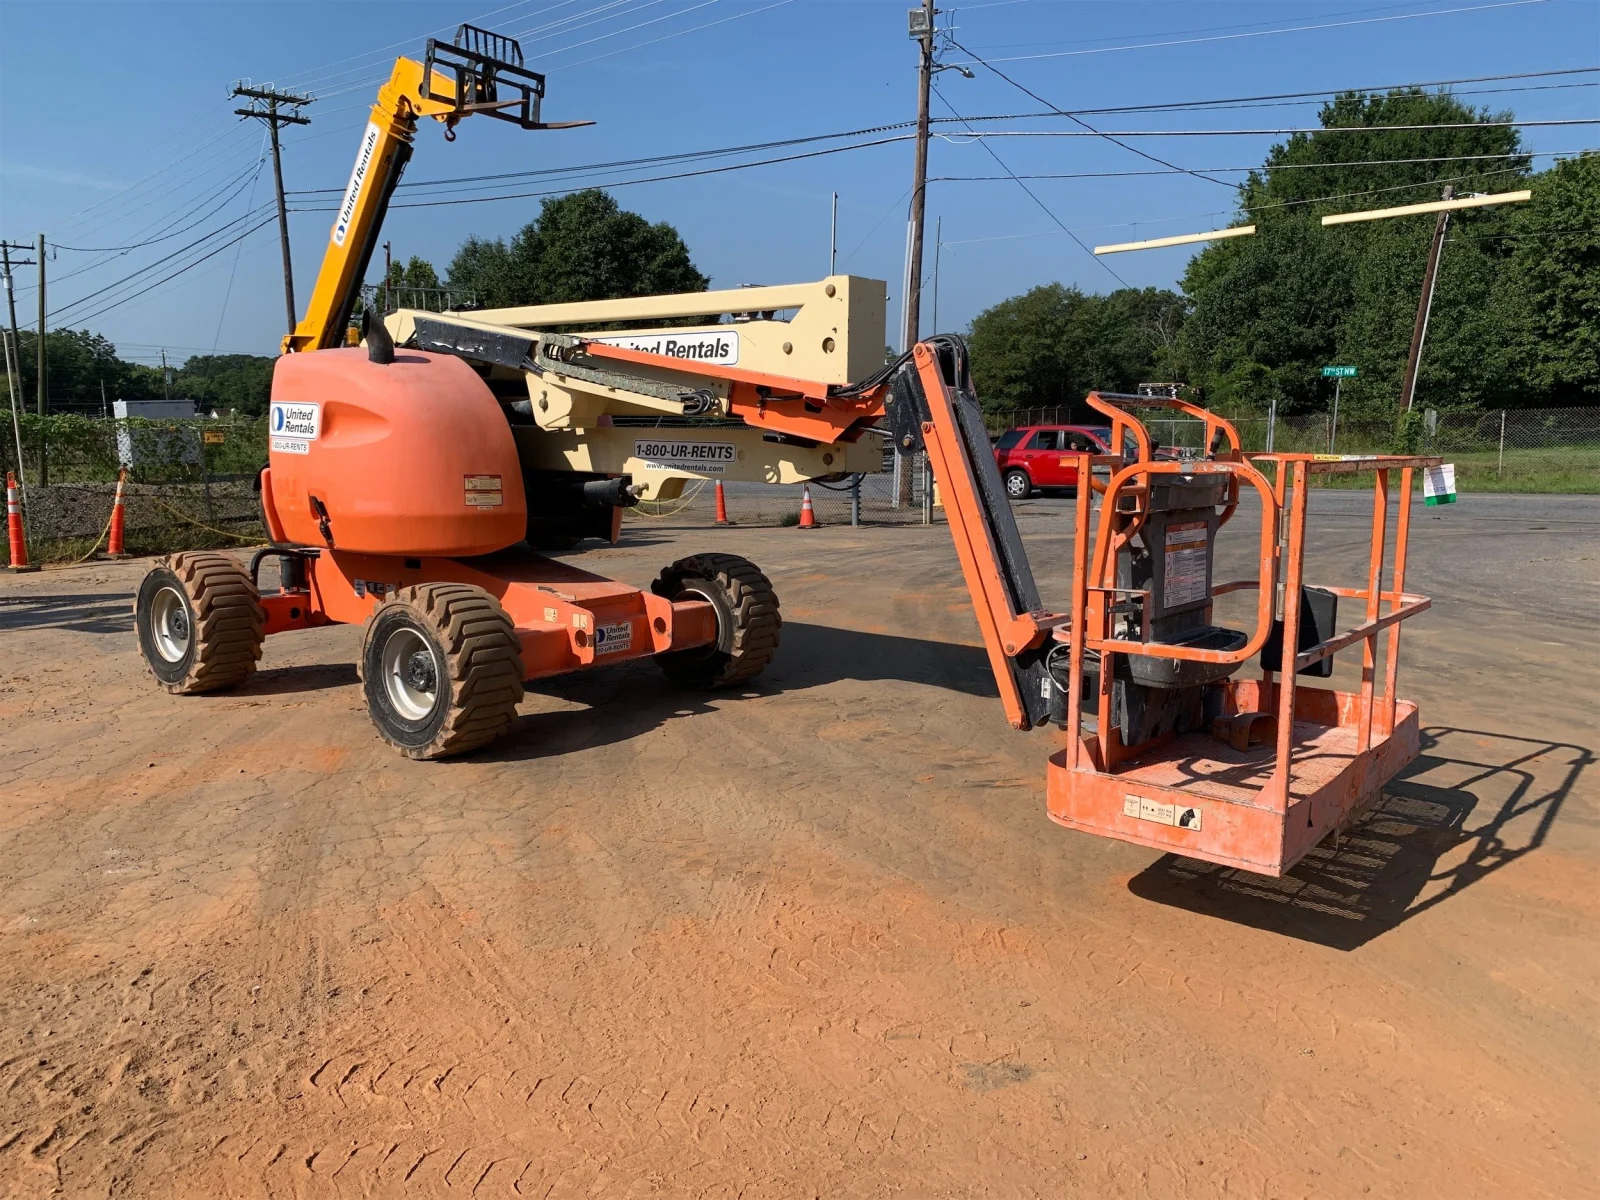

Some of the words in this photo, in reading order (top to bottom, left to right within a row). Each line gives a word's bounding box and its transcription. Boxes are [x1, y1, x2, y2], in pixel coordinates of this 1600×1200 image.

[341, 180, 360, 224] United
[356, 131, 376, 180] Rentals
[665, 338, 730, 359] Rentals
[1335, 367, 1344, 376] ST
[1344, 367, 1355, 376] NW
[286, 408, 313, 420] United
[285, 421, 314, 434] Rentals
[636, 444, 733, 459] 1-800-UR-RENTS
[646, 462, 724, 473] www.unitedrentals.com
[607, 624, 628, 634] United
[606, 631, 630, 642] Rentals
